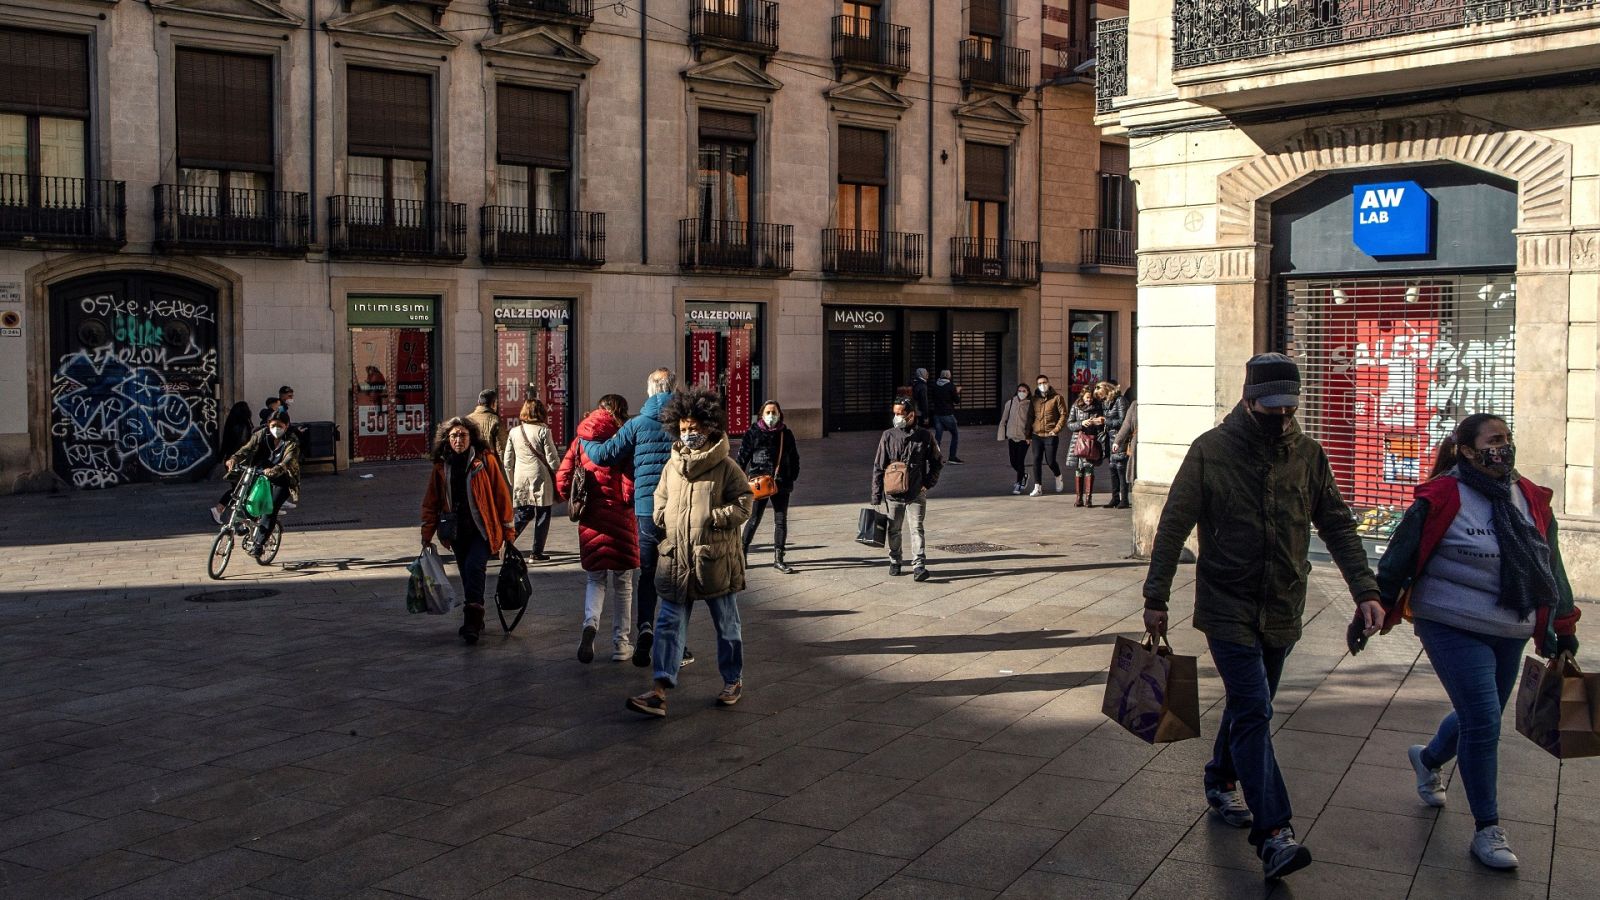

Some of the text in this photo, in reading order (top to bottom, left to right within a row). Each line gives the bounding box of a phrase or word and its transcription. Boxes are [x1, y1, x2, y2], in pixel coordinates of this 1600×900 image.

[1360, 188, 1405, 209] AW
[1359, 211, 1389, 224] LAB
[354, 303, 429, 312] intimissimi
[494, 308, 569, 319] CALZEDONIA
[690, 310, 752, 320] CALZEDONIA
[835, 311, 885, 323] MANGO
[505, 342, 519, 367] 50
[698, 339, 710, 362] 50
[506, 377, 519, 402] 50
